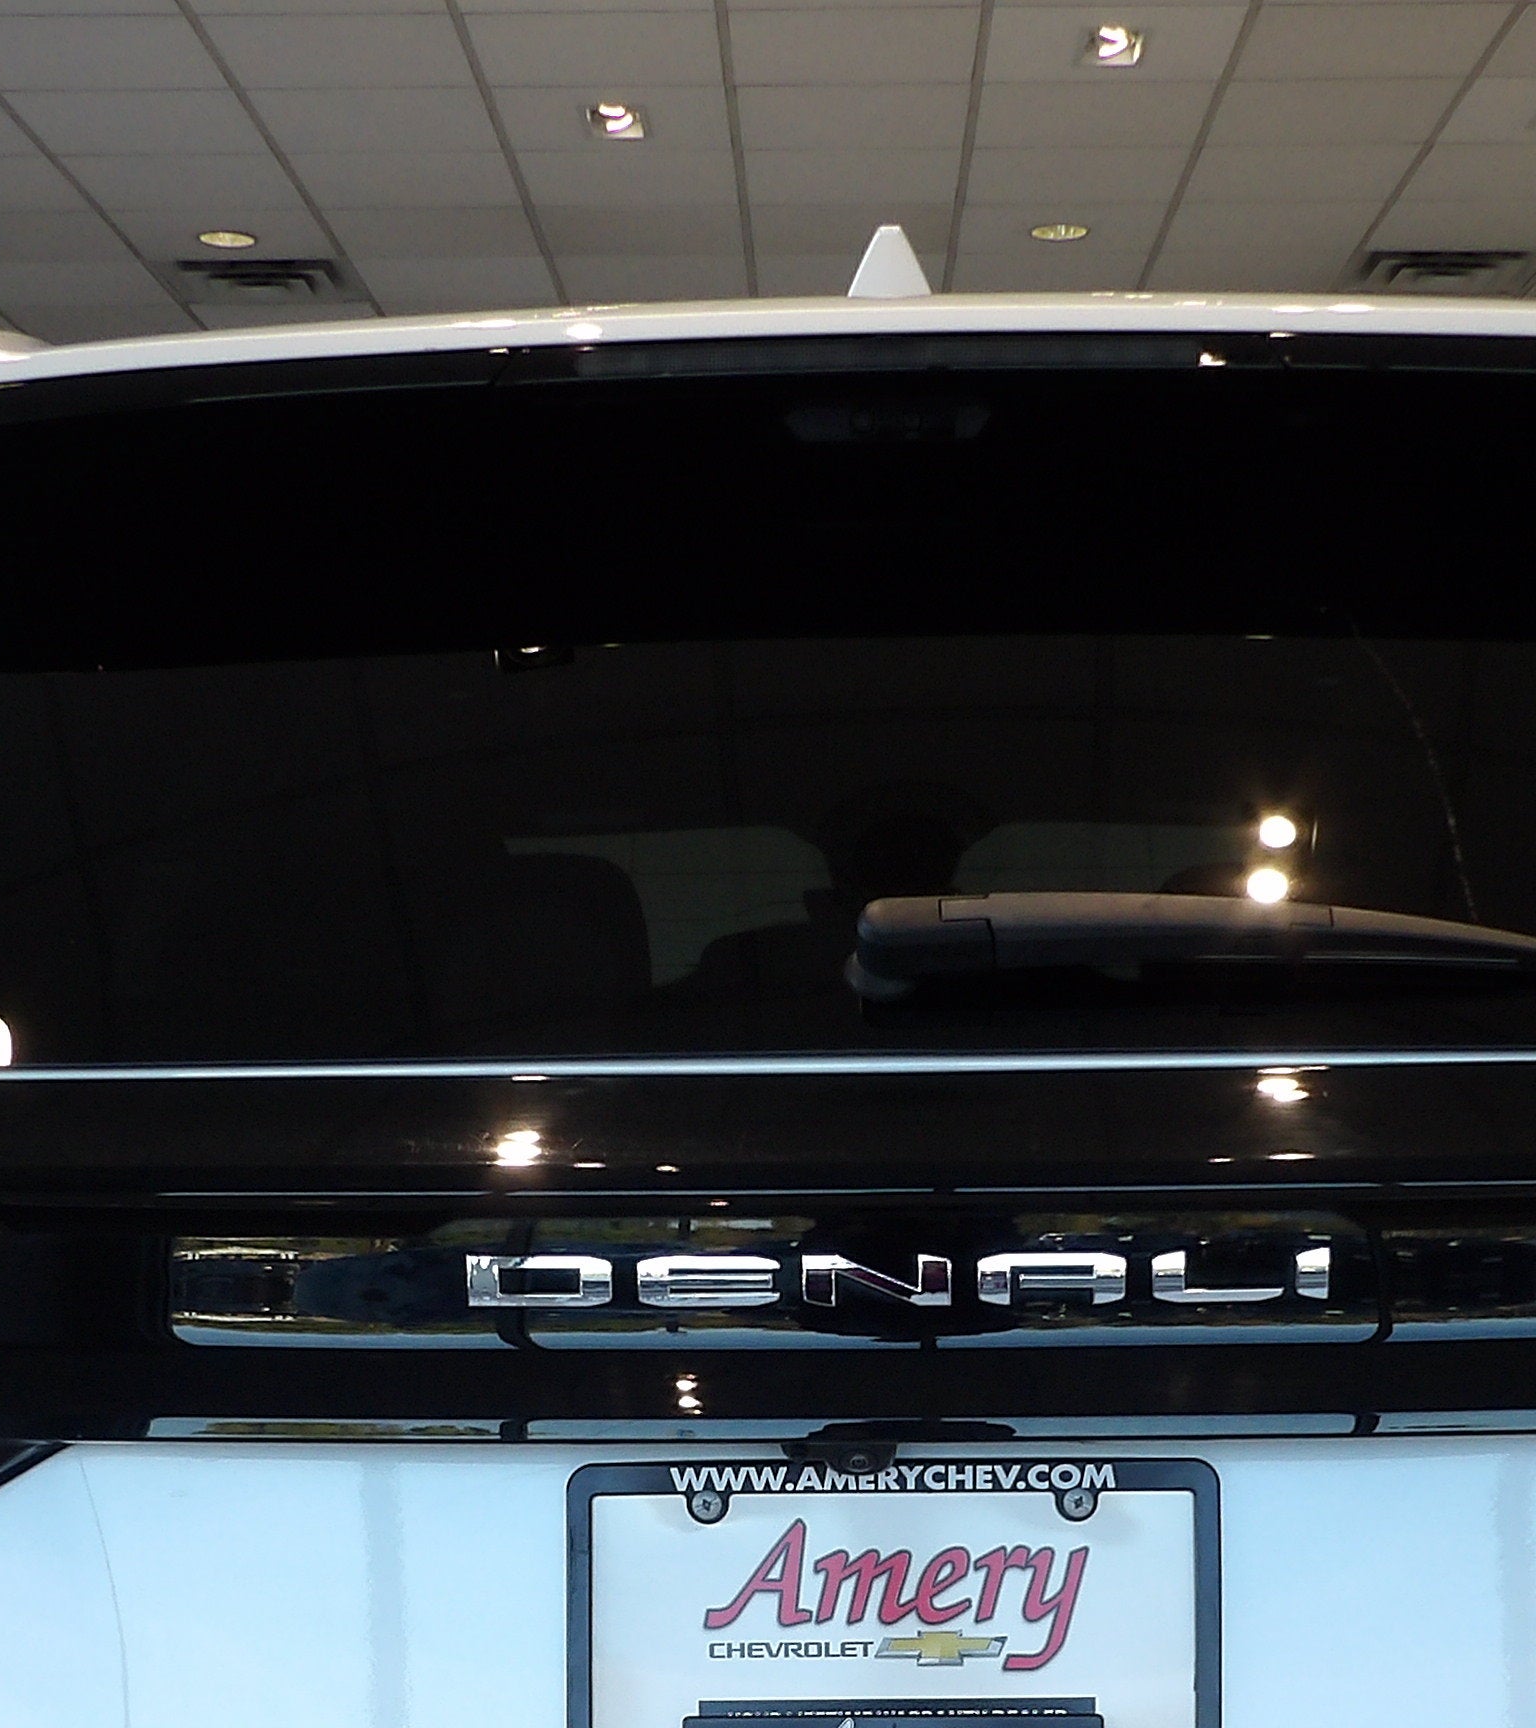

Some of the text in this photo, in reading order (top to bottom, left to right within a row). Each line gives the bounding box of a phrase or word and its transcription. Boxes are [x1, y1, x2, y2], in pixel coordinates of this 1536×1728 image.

[466, 1248, 1332, 1306] DENALI
[669, 1463, 1117, 1491] WWW.AMERYCHEV.COM
[703, 1519, 1089, 1671] Amery
[708, 1640, 875, 1659] CHEVROLET
